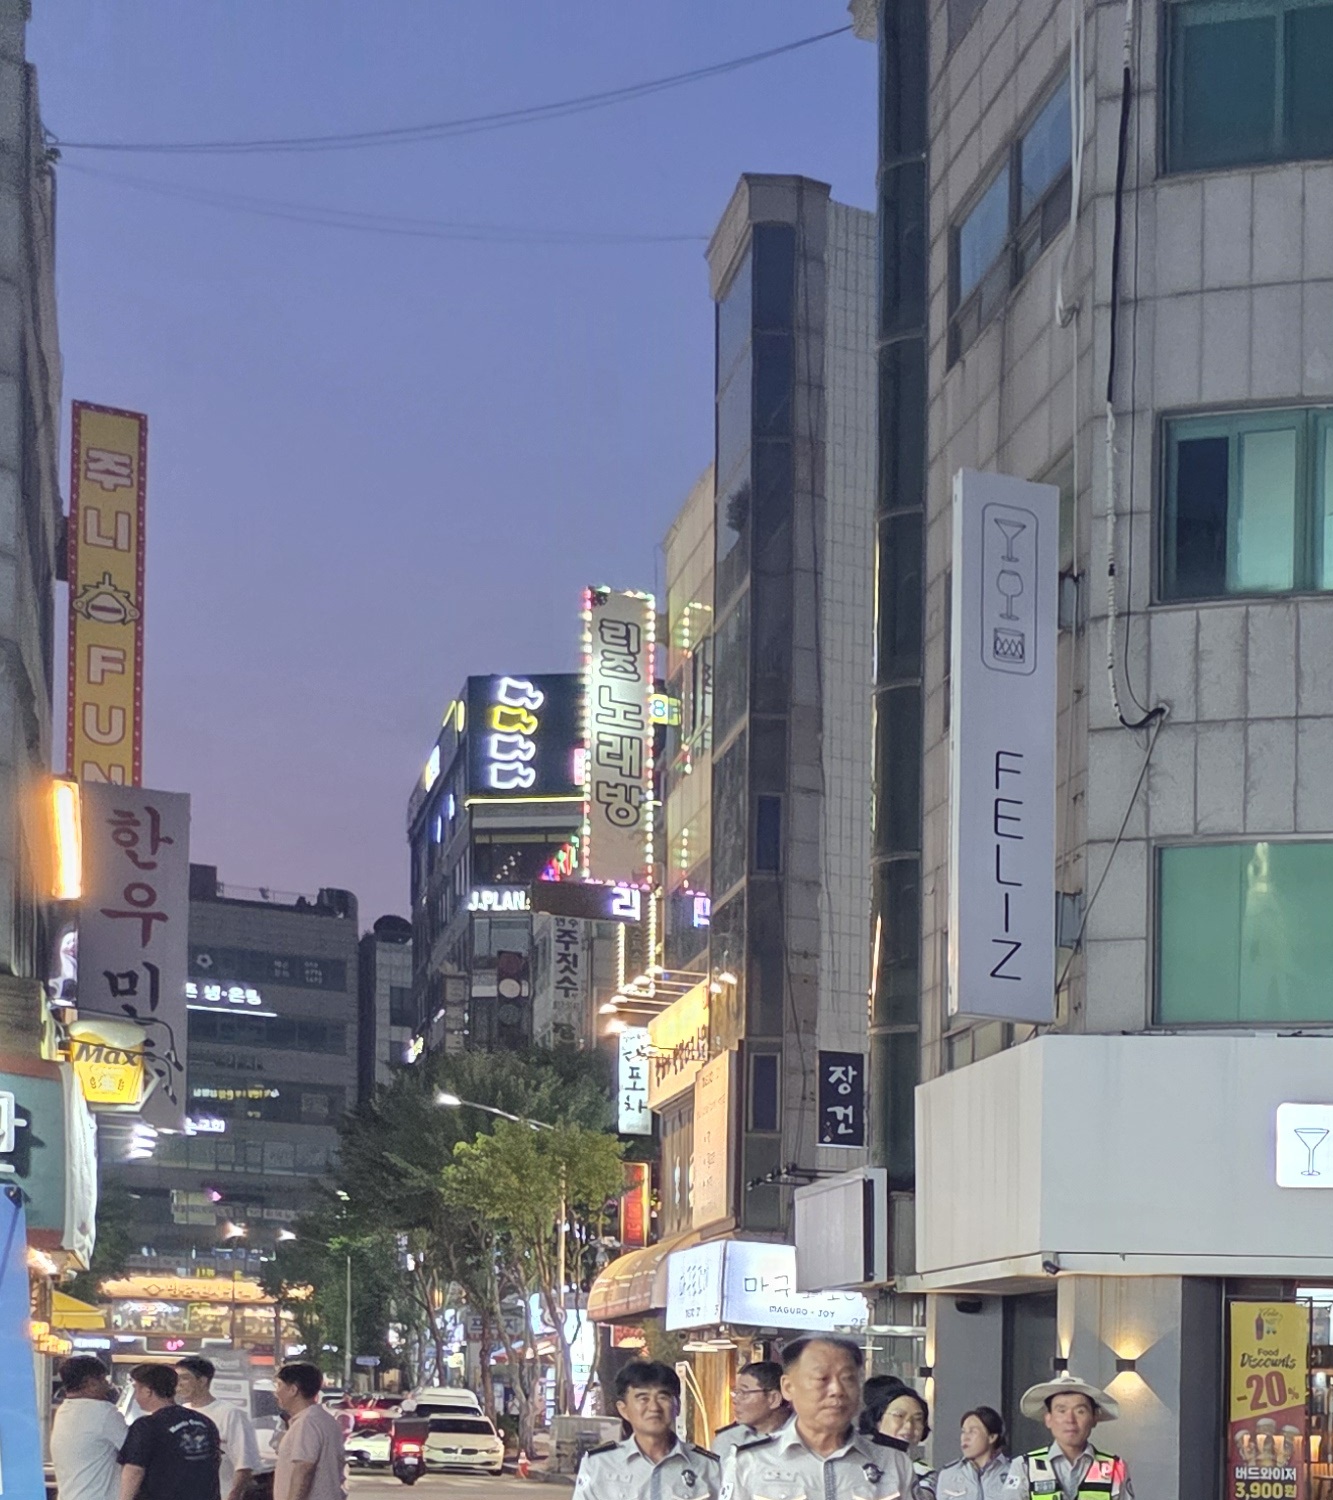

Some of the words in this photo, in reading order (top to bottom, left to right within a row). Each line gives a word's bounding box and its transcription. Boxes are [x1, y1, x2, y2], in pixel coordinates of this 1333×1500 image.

[85, 447, 133, 553] 주니
[989, 750, 1024, 981] FELIZ
[555, 928, 579, 998] 주짓수
[75, 1043, 138, 1067] Max
[827, 1066, 857, 1135] 장건
[1257, 1348, 1279, 1356] Food
[1235, 1466, 1296, 1481] 버드와이저
